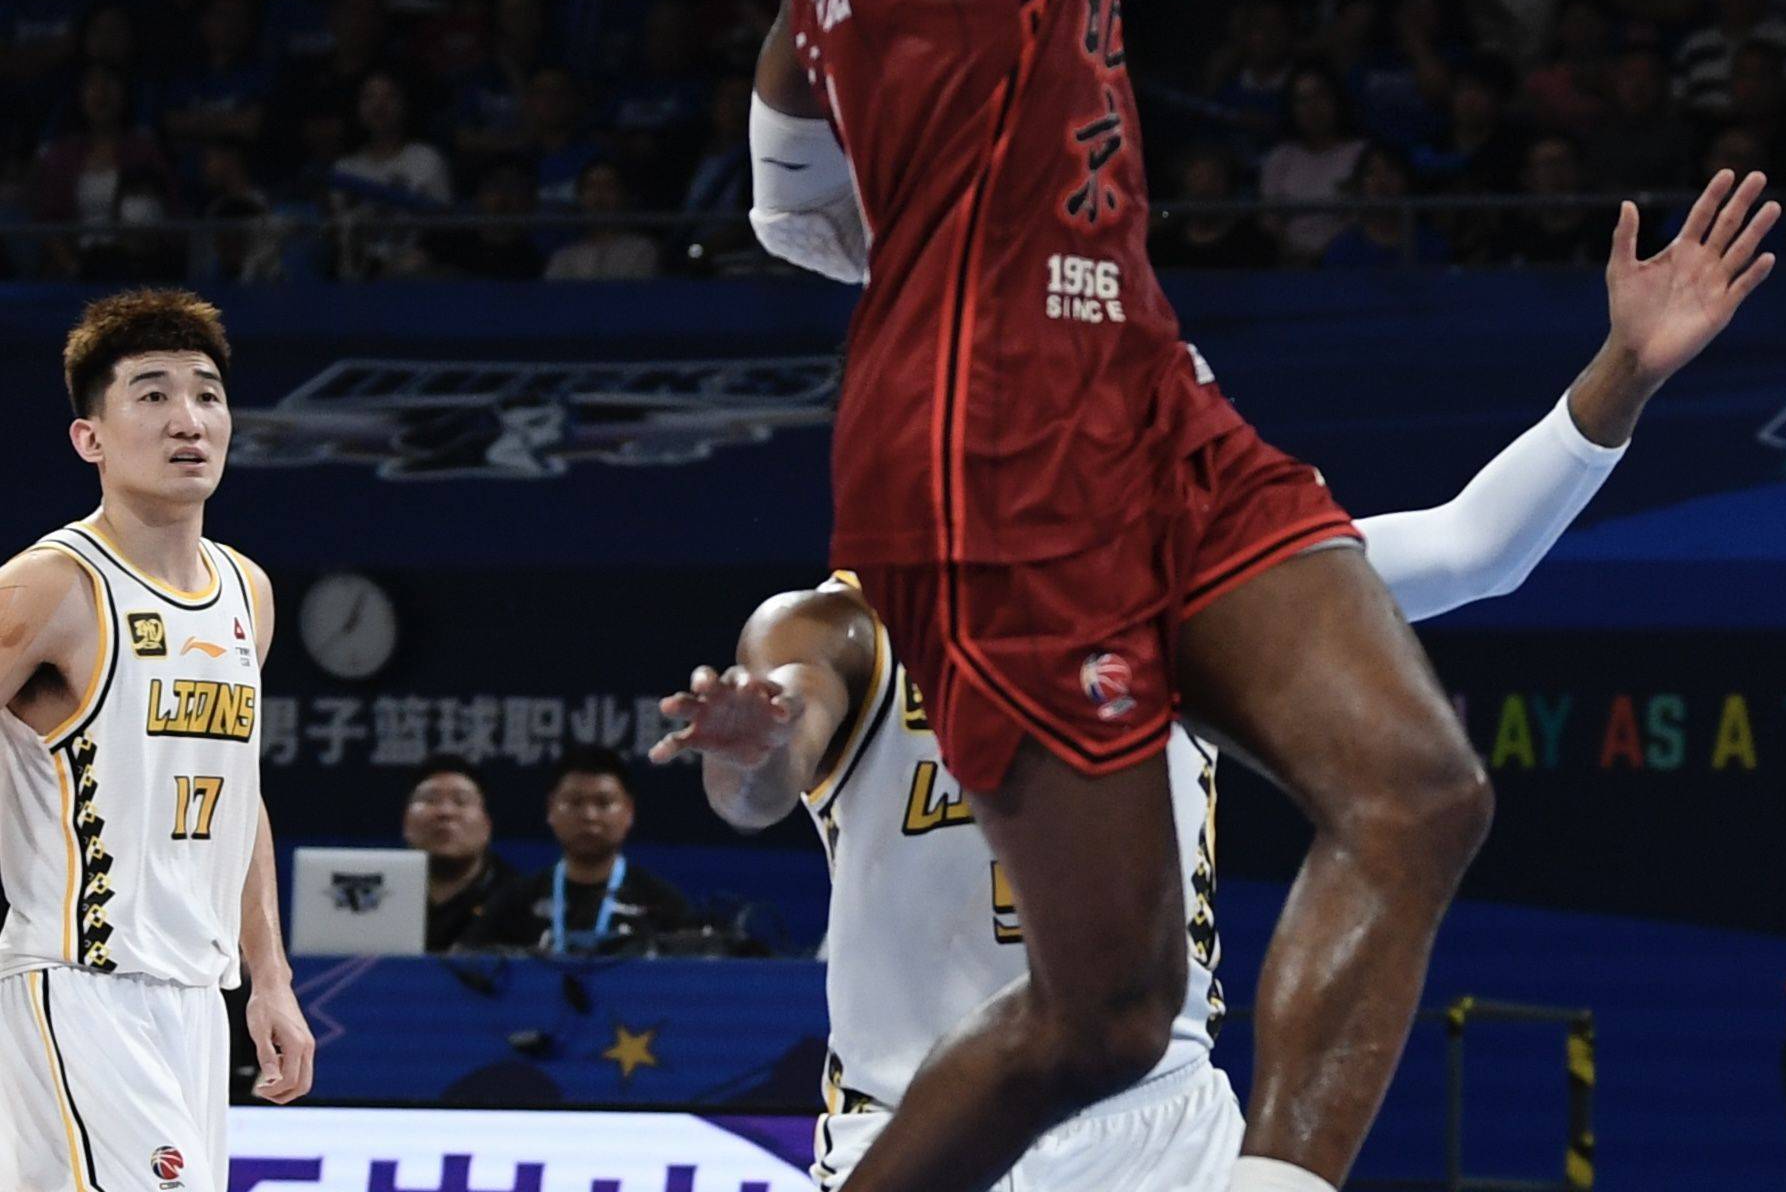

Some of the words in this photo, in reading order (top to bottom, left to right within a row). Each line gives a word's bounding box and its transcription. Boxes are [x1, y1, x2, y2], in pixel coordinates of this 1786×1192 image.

[1046, 294, 1126, 323] SINCE
[147, 679, 255, 743] LIONS
[1600, 693, 1687, 769] AS
[1711, 693, 1757, 769] A
[171, 776, 224, 840] 17
